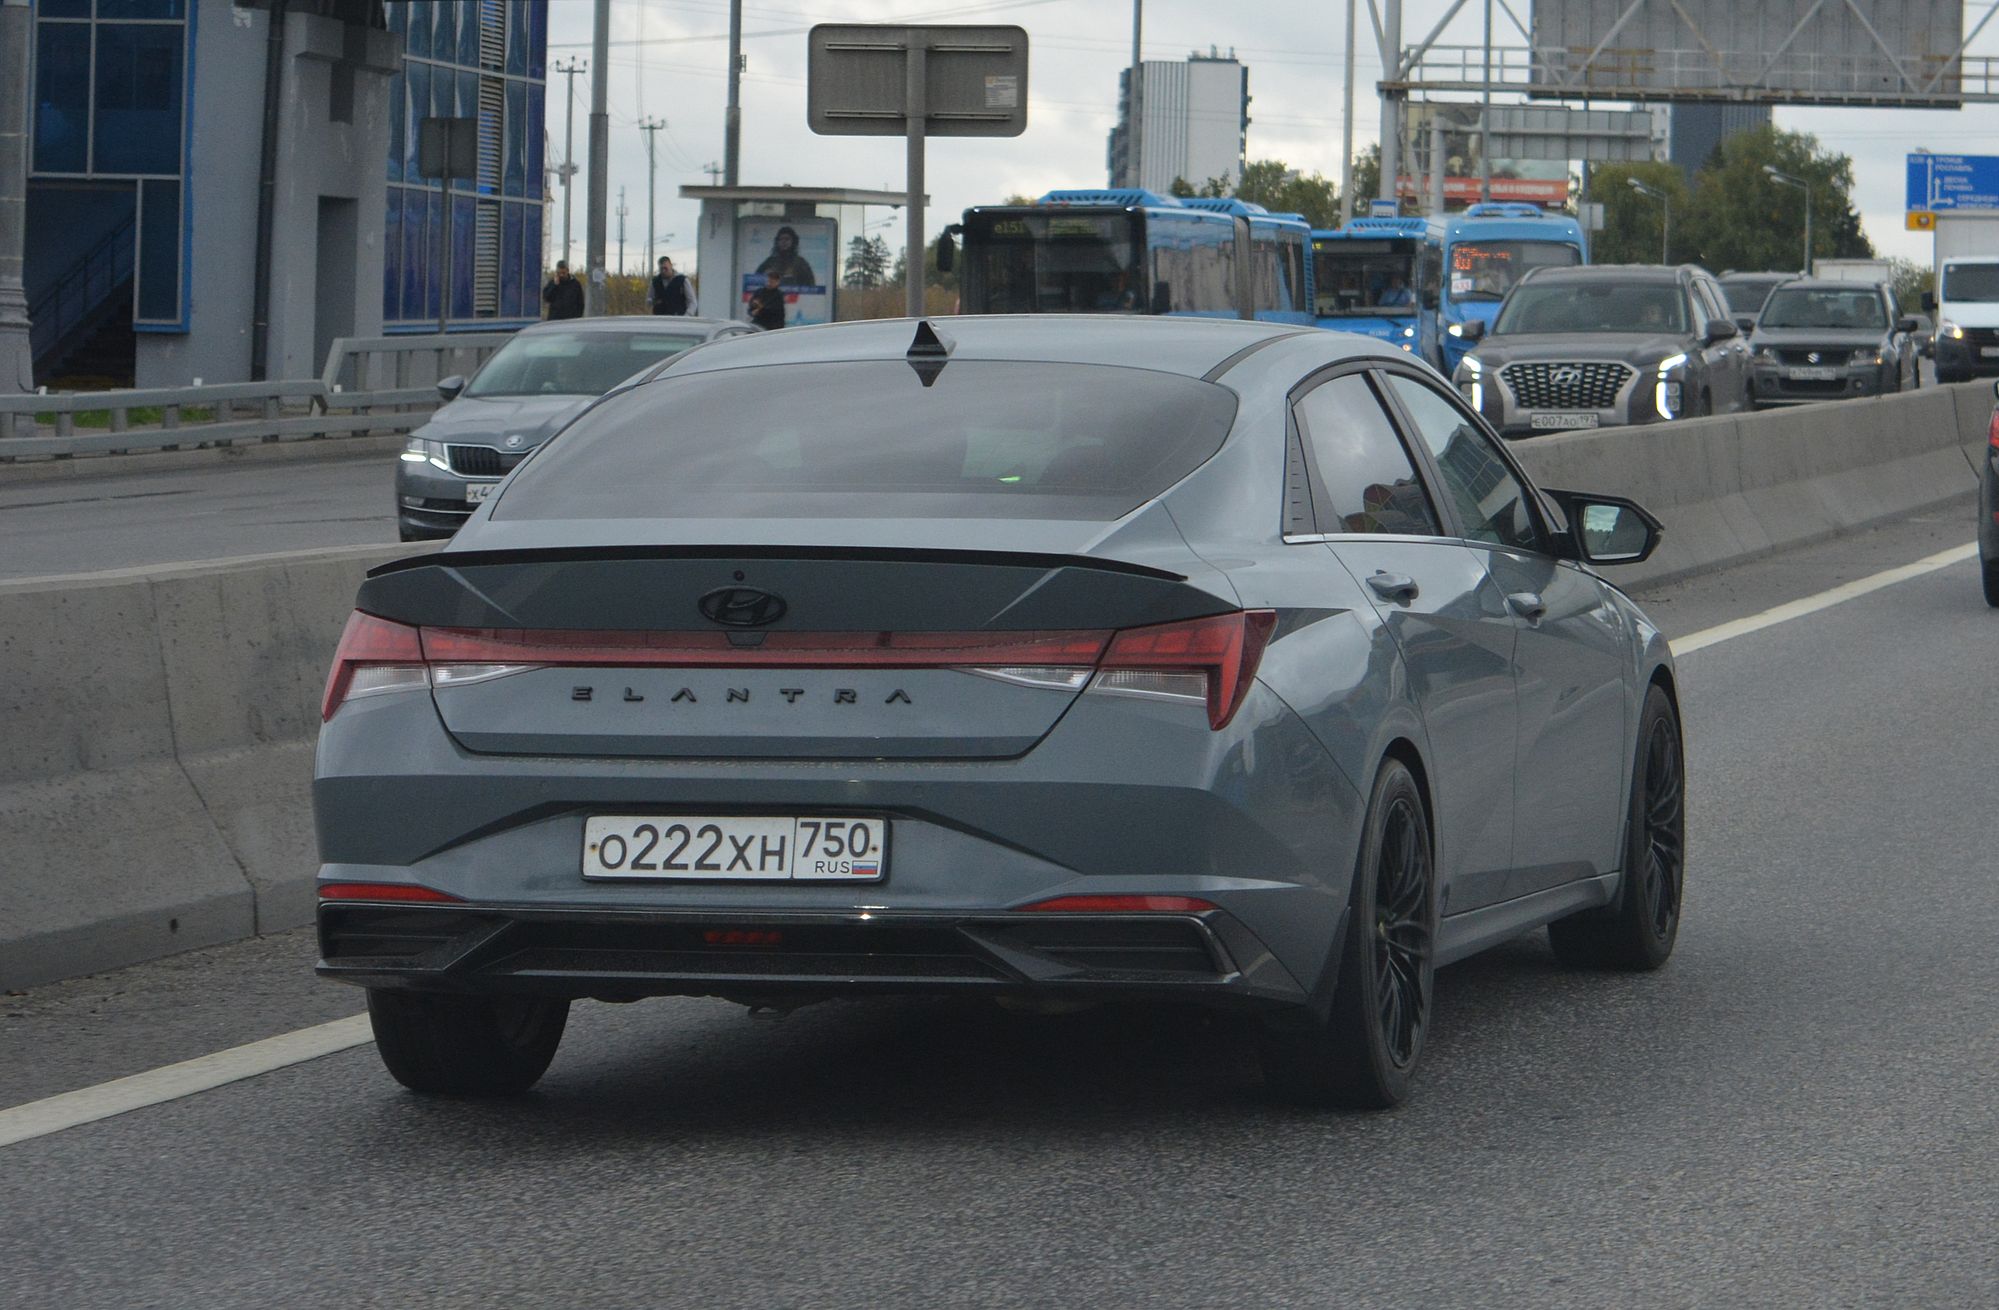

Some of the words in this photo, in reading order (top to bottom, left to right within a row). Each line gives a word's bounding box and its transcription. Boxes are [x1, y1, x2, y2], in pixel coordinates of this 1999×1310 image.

[571, 686, 913, 704] ELANTRA
[800, 821, 870, 858] 750
[815, 860, 850, 875] RUS
